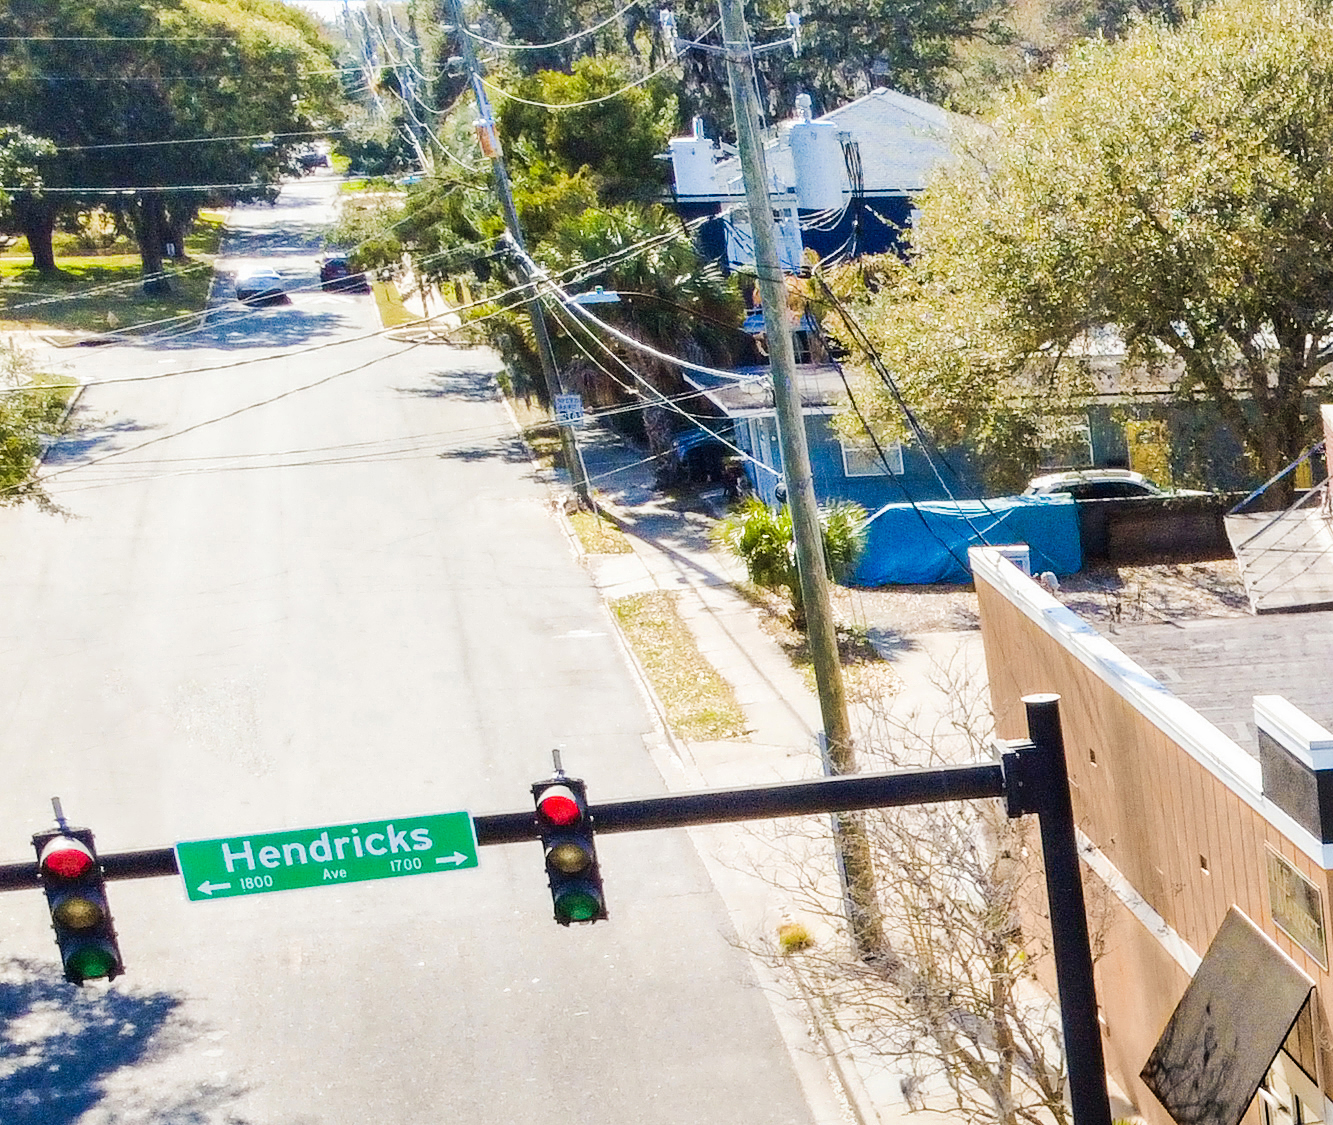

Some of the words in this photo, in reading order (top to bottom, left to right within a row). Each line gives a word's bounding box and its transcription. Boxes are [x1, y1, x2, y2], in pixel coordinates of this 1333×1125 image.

[221, 824, 434, 873] Hendricks
[240, 875, 274, 891] 1800
[322, 868, 348, 881] Ave
[389, 857, 422, 872] 1700
